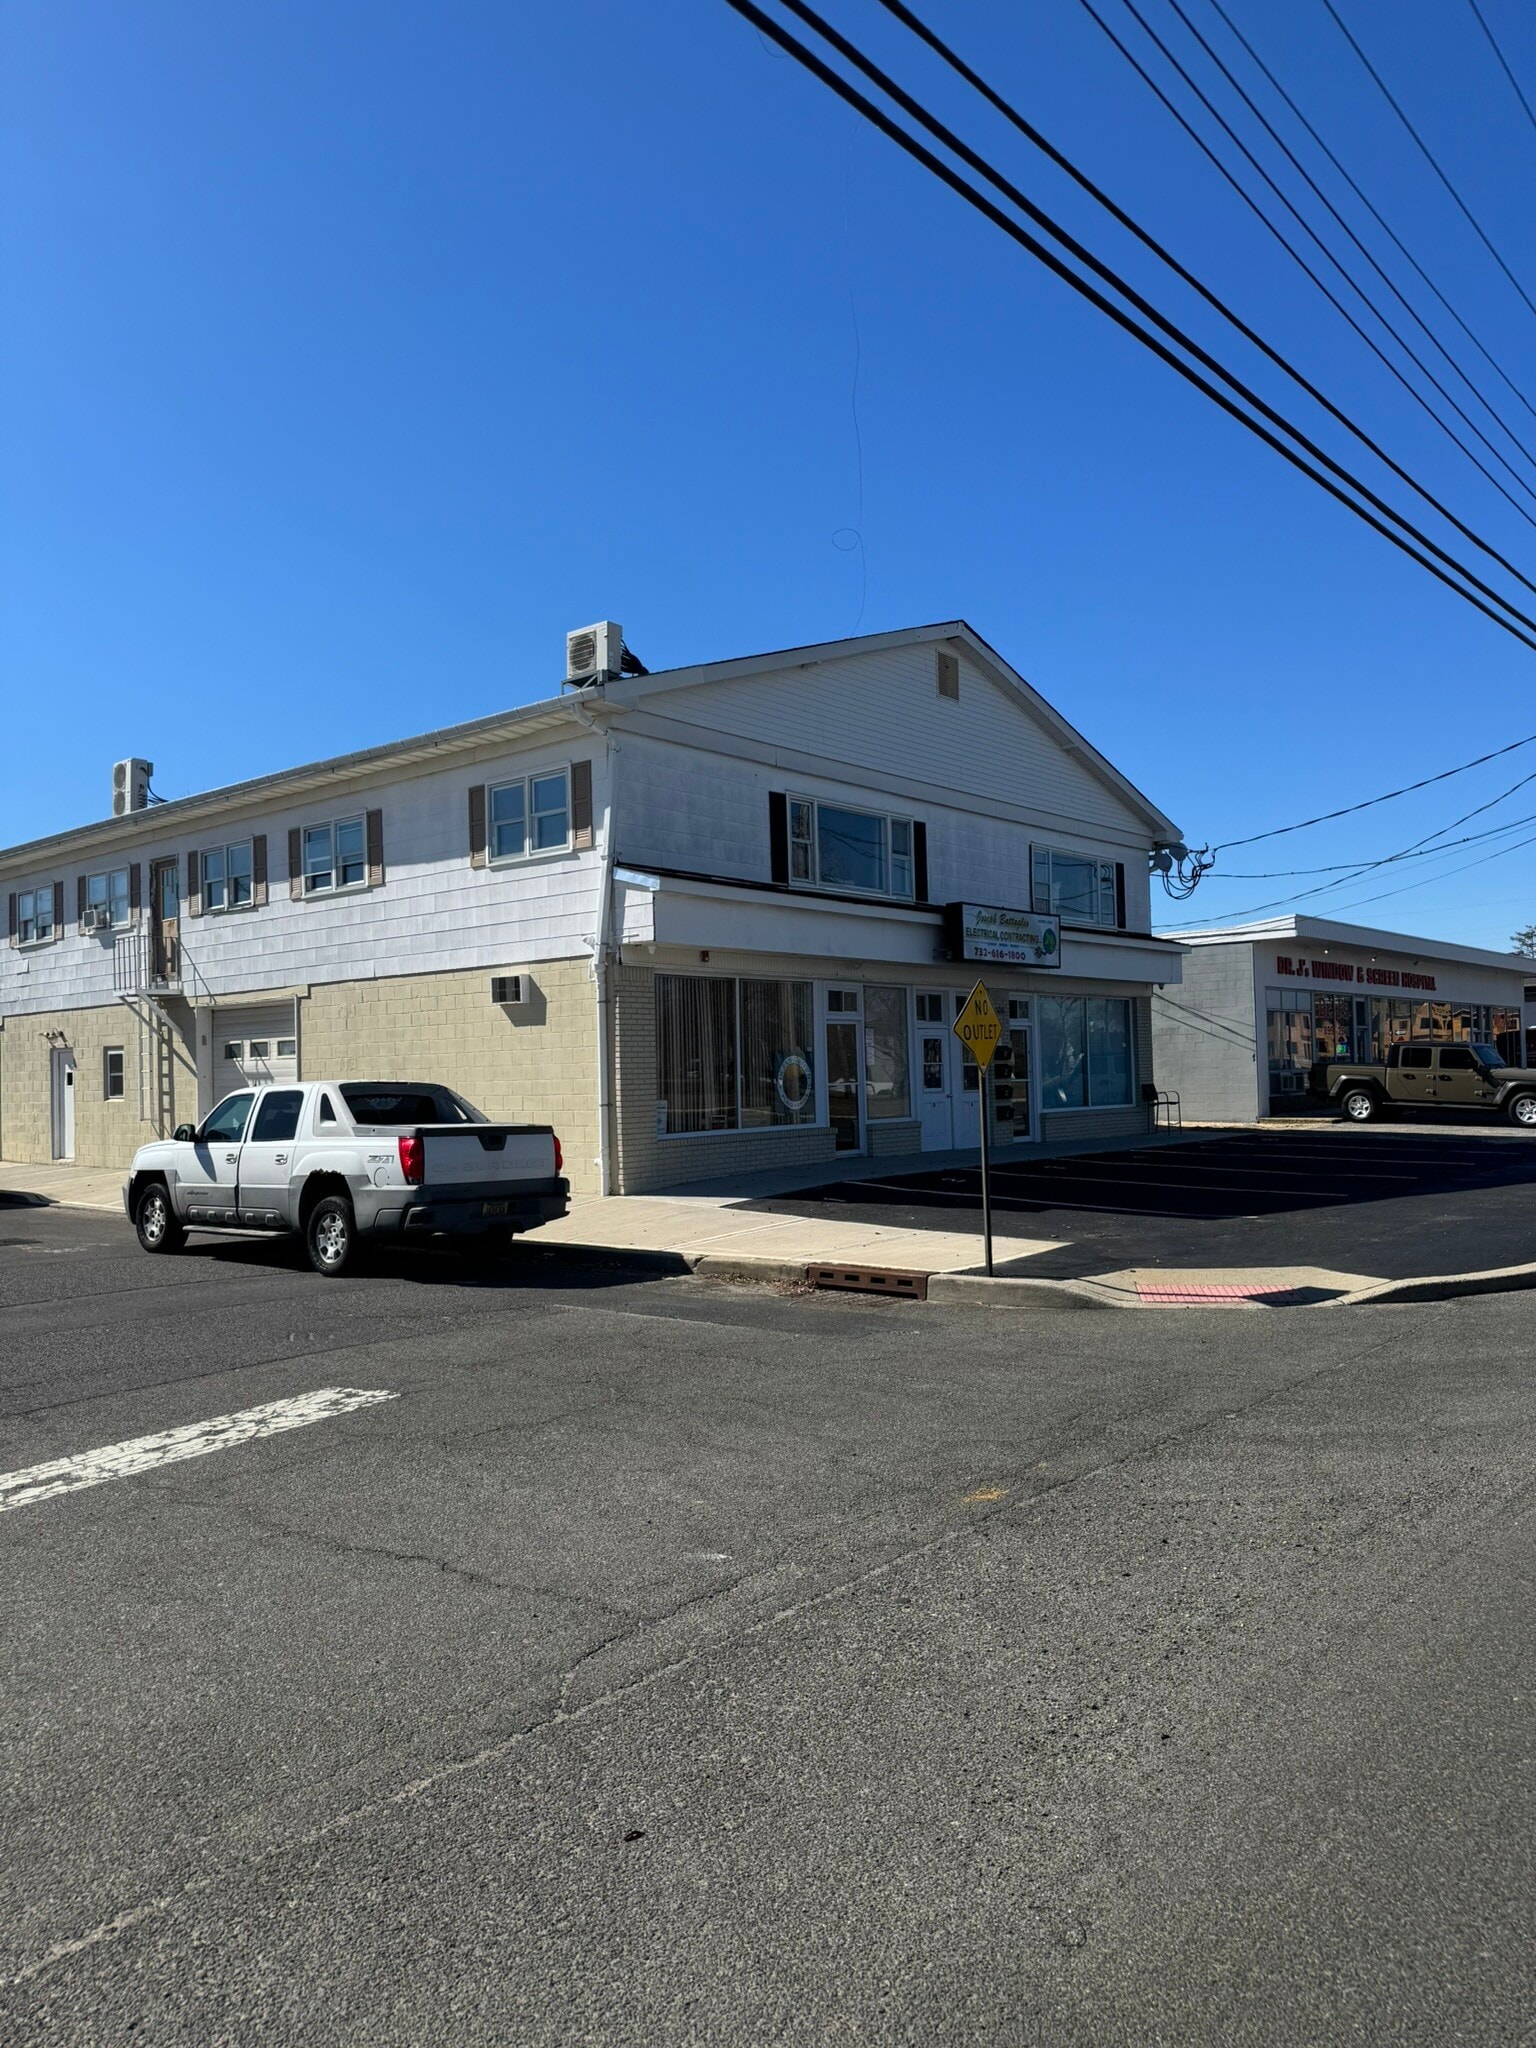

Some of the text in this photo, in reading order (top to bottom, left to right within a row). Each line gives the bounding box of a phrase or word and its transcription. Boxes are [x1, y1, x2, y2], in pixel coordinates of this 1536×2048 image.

[965, 927, 1040, 945] ELECTRICAL CONTRACTING
[974, 946, 1026, 960] 732-616-1800
[1276, 956, 1296, 975] DR.
[1311, 960, 1354, 981] WINDOW
[1357, 966, 1365, 983] &
[1366, 967, 1400, 987] SCREEN
[1401, 972, 1437, 991] HOSPITAL
[974, 1000, 988, 1015] NO
[963, 1024, 997, 1040] OUTLET
[367, 1154, 395, 1164] Z71
[432, 1158, 550, 1174] CHEVROLET
